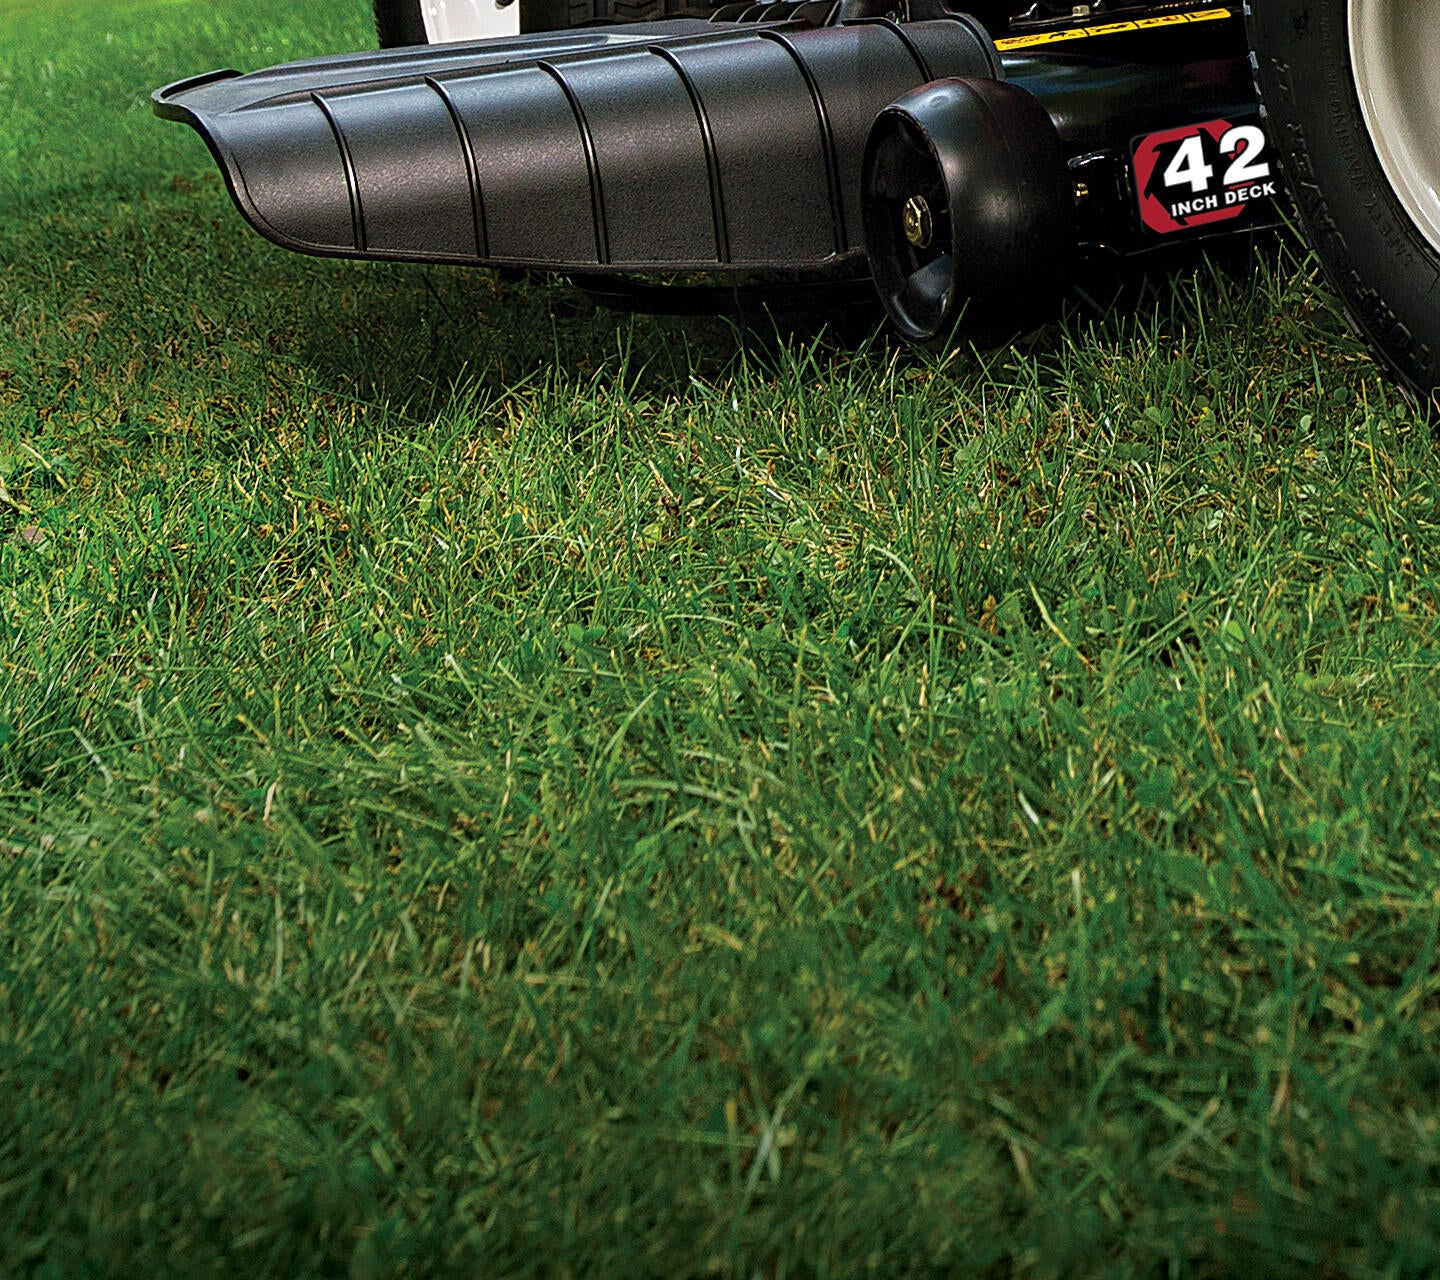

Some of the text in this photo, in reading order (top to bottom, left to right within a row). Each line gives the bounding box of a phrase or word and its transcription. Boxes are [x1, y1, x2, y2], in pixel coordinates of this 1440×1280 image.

[1163, 125, 1270, 193] 42
[1171, 181, 1277, 217] INCH DECK
